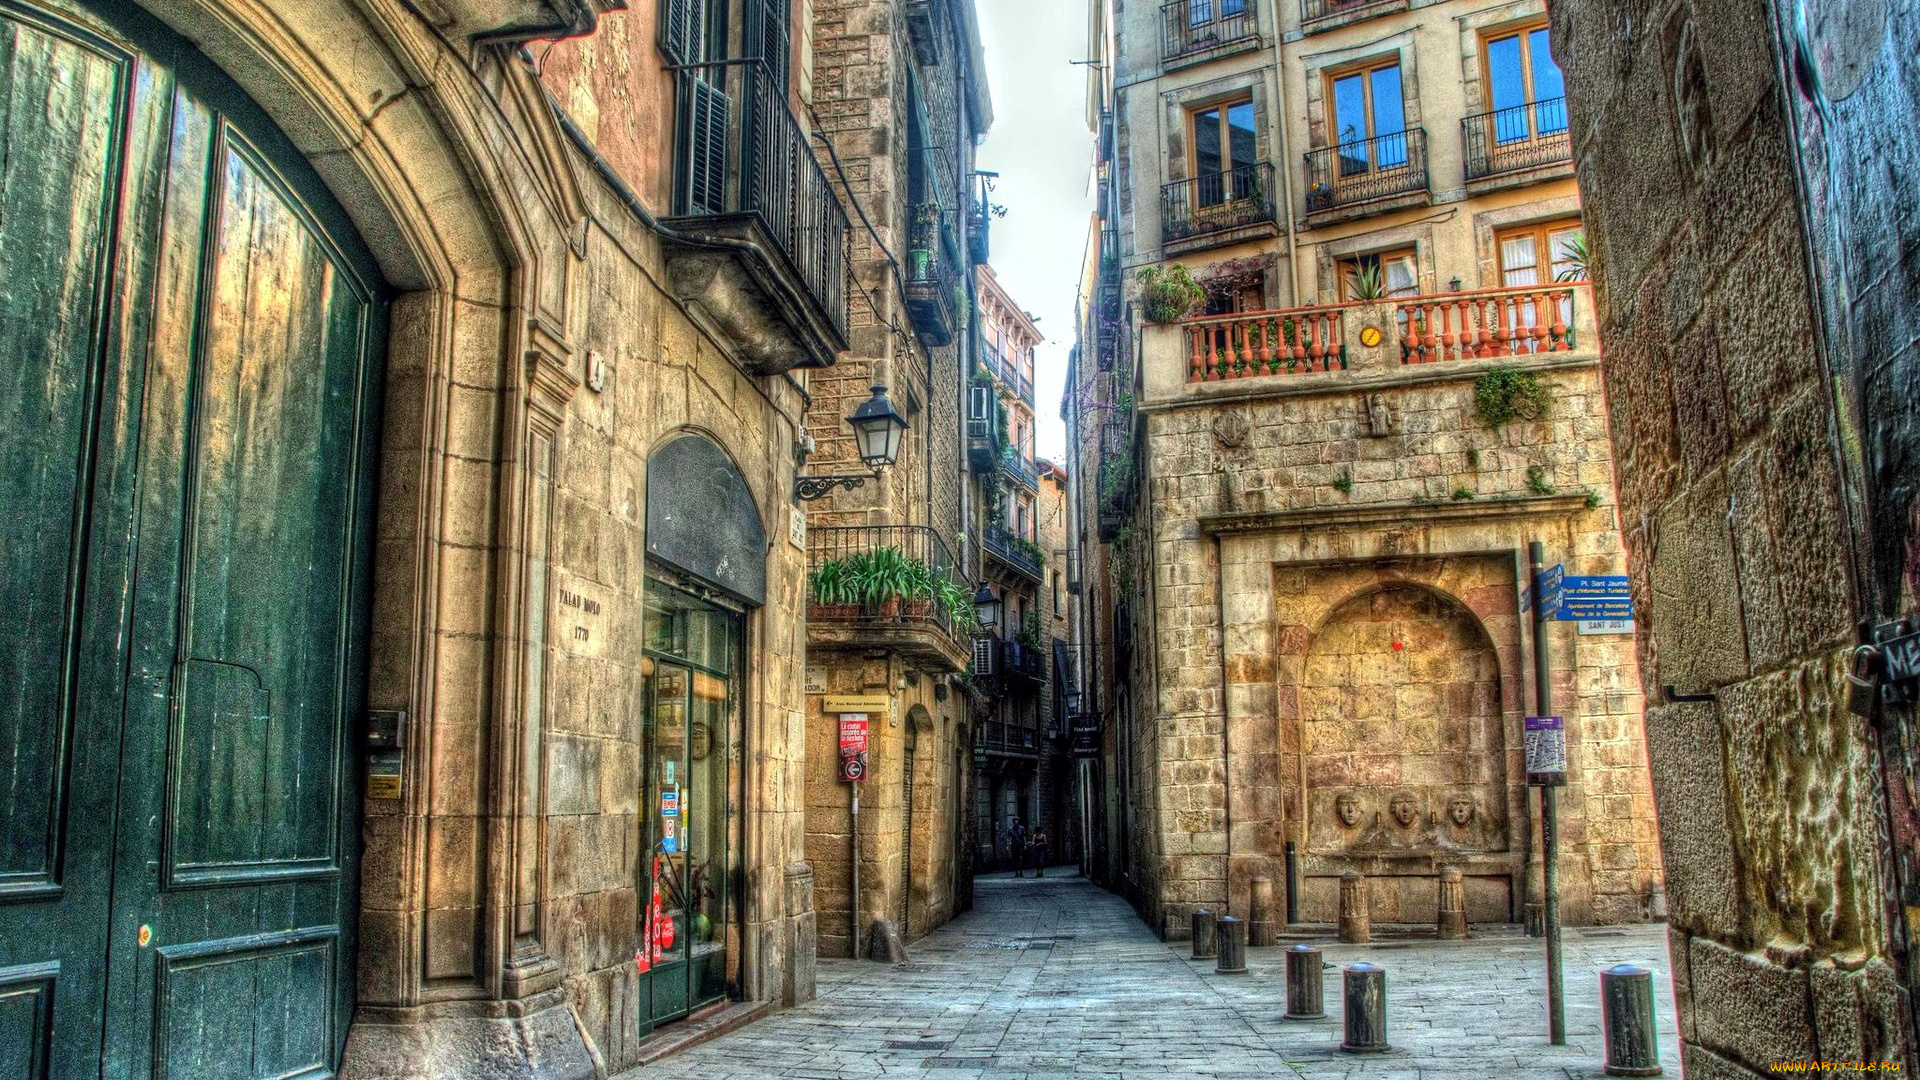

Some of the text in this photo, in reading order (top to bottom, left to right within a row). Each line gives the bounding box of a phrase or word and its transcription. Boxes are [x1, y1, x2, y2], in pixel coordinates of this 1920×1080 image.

[559, 589, 581, 609] PALAU
[1588, 620, 1625, 630] SANT JUST
